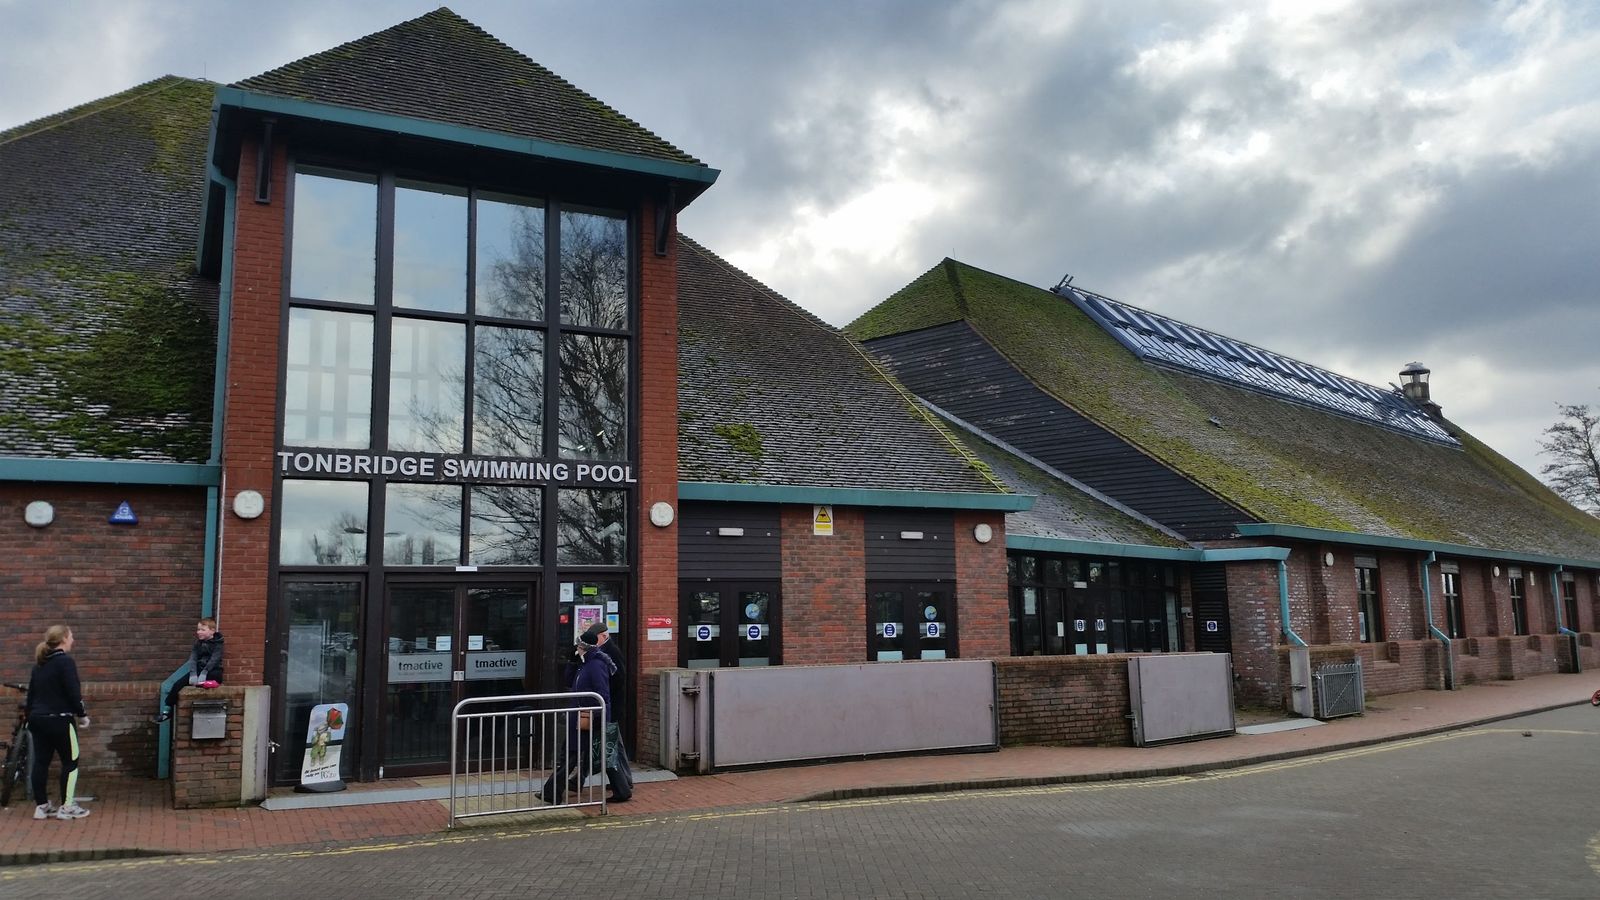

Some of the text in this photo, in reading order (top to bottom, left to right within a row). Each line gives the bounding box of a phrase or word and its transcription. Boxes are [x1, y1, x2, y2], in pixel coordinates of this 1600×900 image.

[277, 452, 637, 483] TONBRIDGE SWIMMING POOL
[398, 660, 443, 671] tmactive
[475, 657, 518, 668] tmactive
